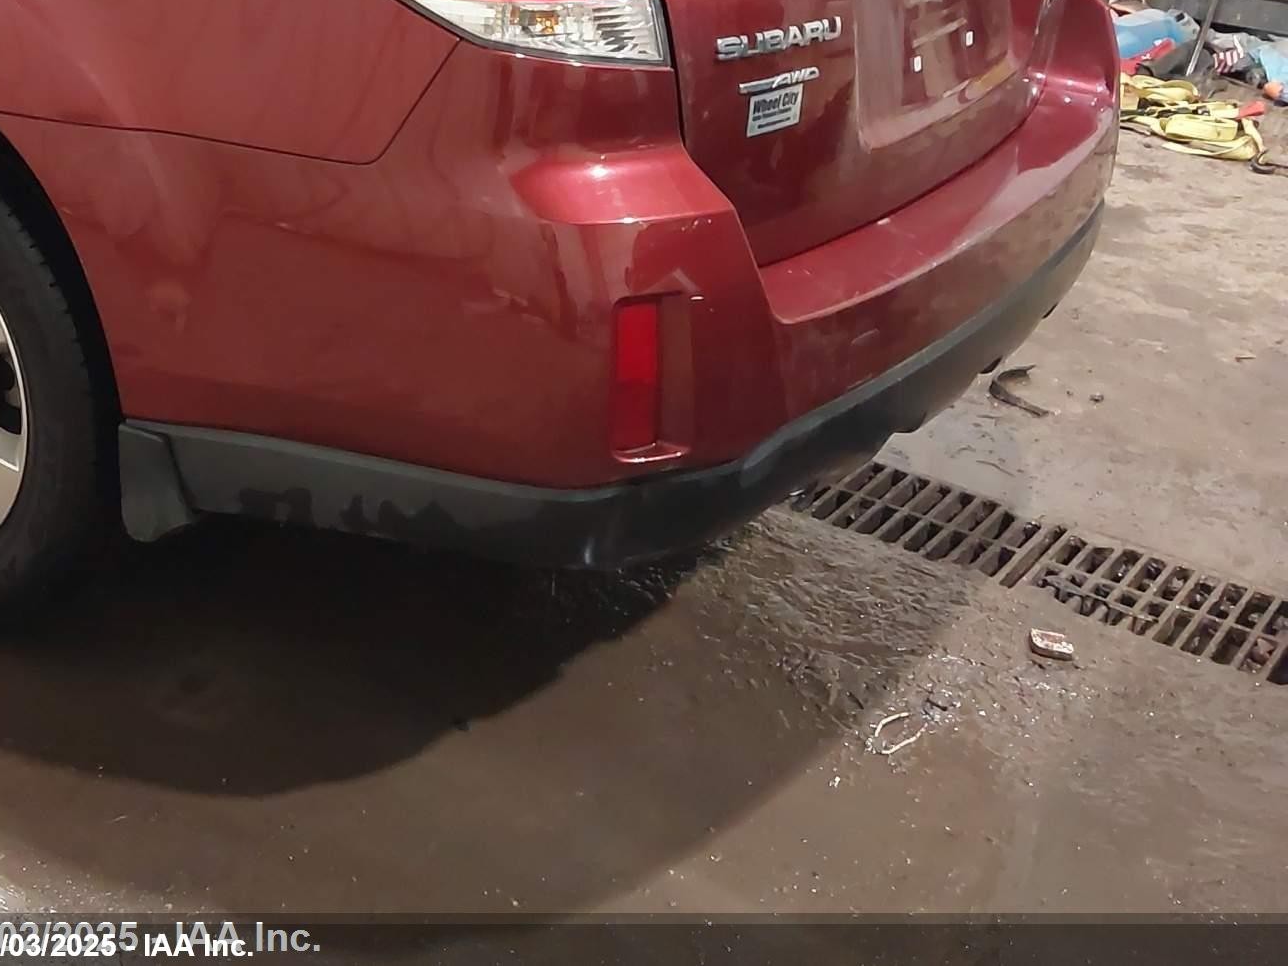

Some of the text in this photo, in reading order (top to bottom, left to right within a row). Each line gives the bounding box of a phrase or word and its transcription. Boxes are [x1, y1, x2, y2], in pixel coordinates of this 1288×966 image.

[716, 15, 843, 61] SUBARU
[772, 66, 821, 89] AWD
[753, 94, 782, 115] Wheel
[782, 90, 800, 108] City
